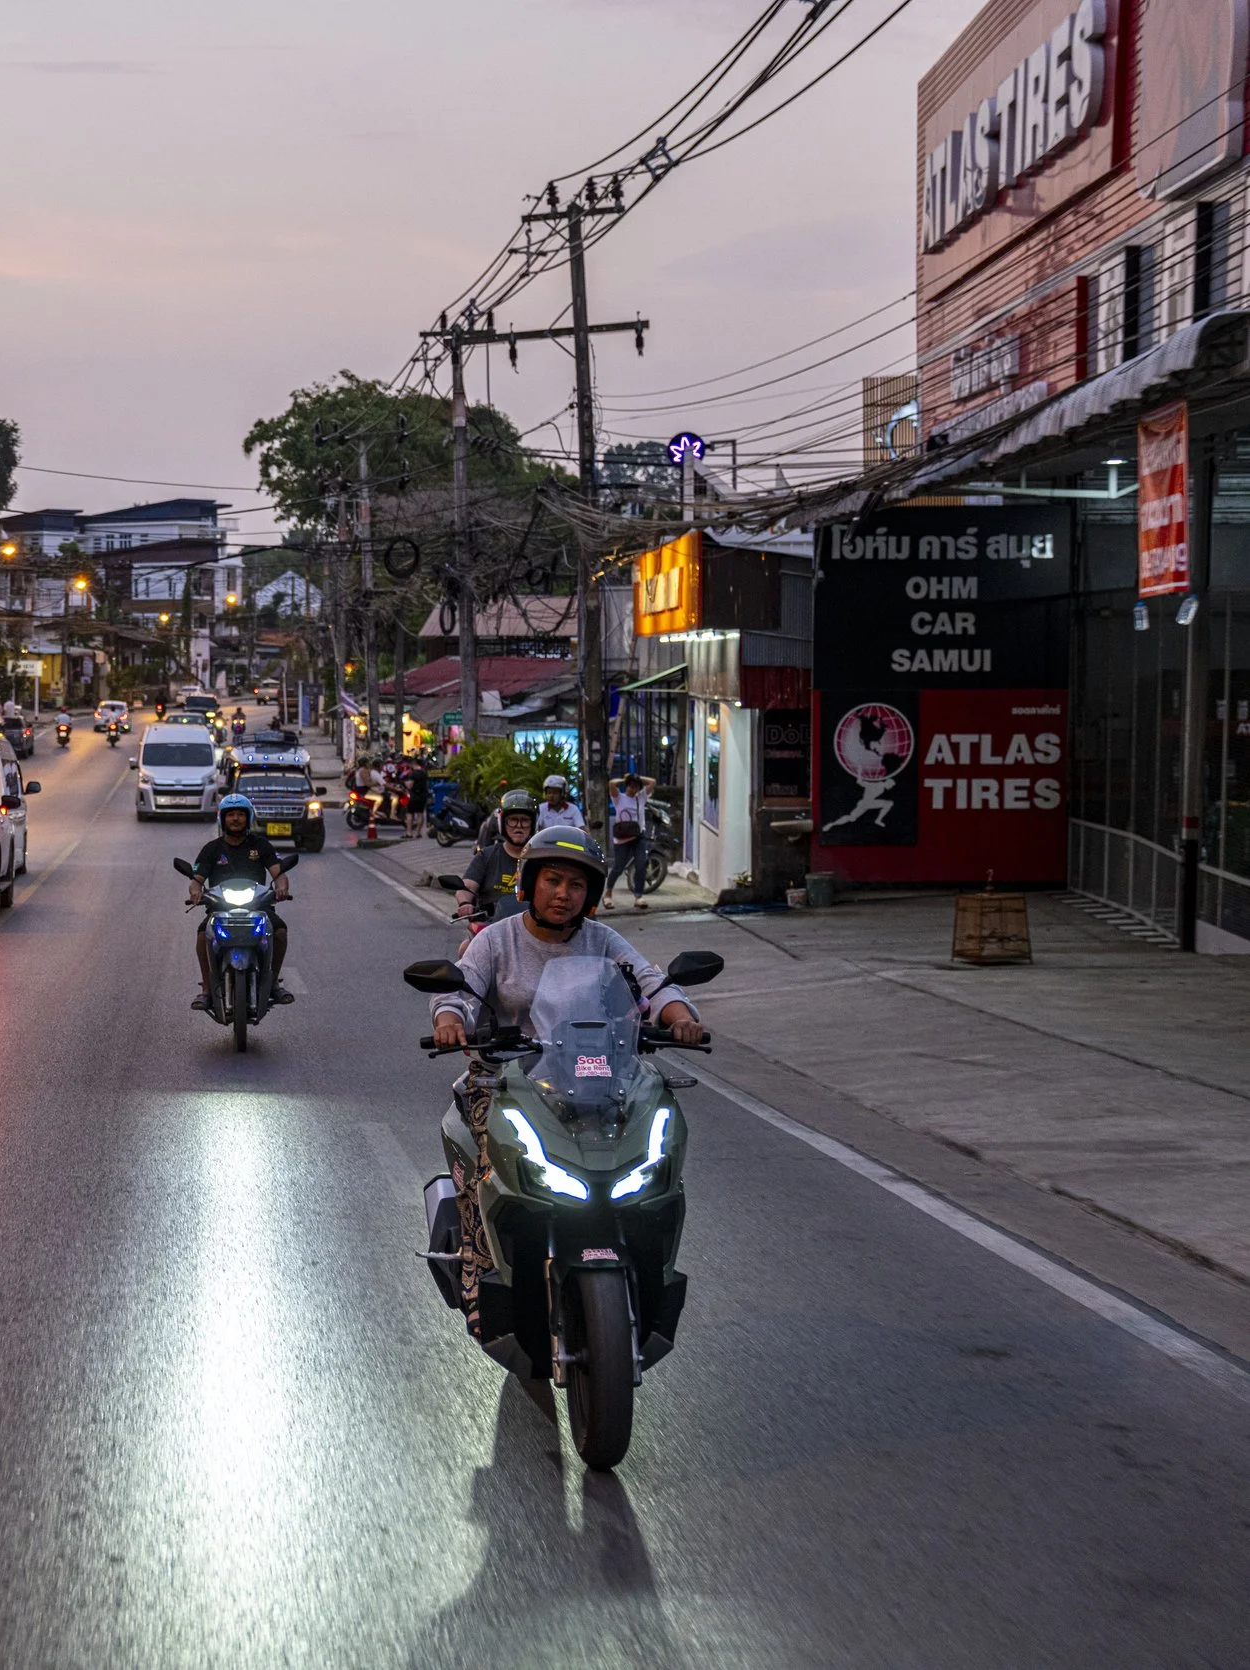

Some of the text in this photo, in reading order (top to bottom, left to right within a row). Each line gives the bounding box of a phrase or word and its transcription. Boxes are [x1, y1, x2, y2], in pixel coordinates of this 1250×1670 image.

[922, 0, 1106, 254] ATLAS TIRES
[918, 527, 978, 559] คาร์
[905, 576, 978, 599] OHM
[910, 612, 976, 635] CAR
[891, 649, 992, 672] SAMUI
[924, 733, 1061, 765] ATLAS
[924, 779, 1061, 810] TIRES
[578, 1056, 606, 1065] Saai
